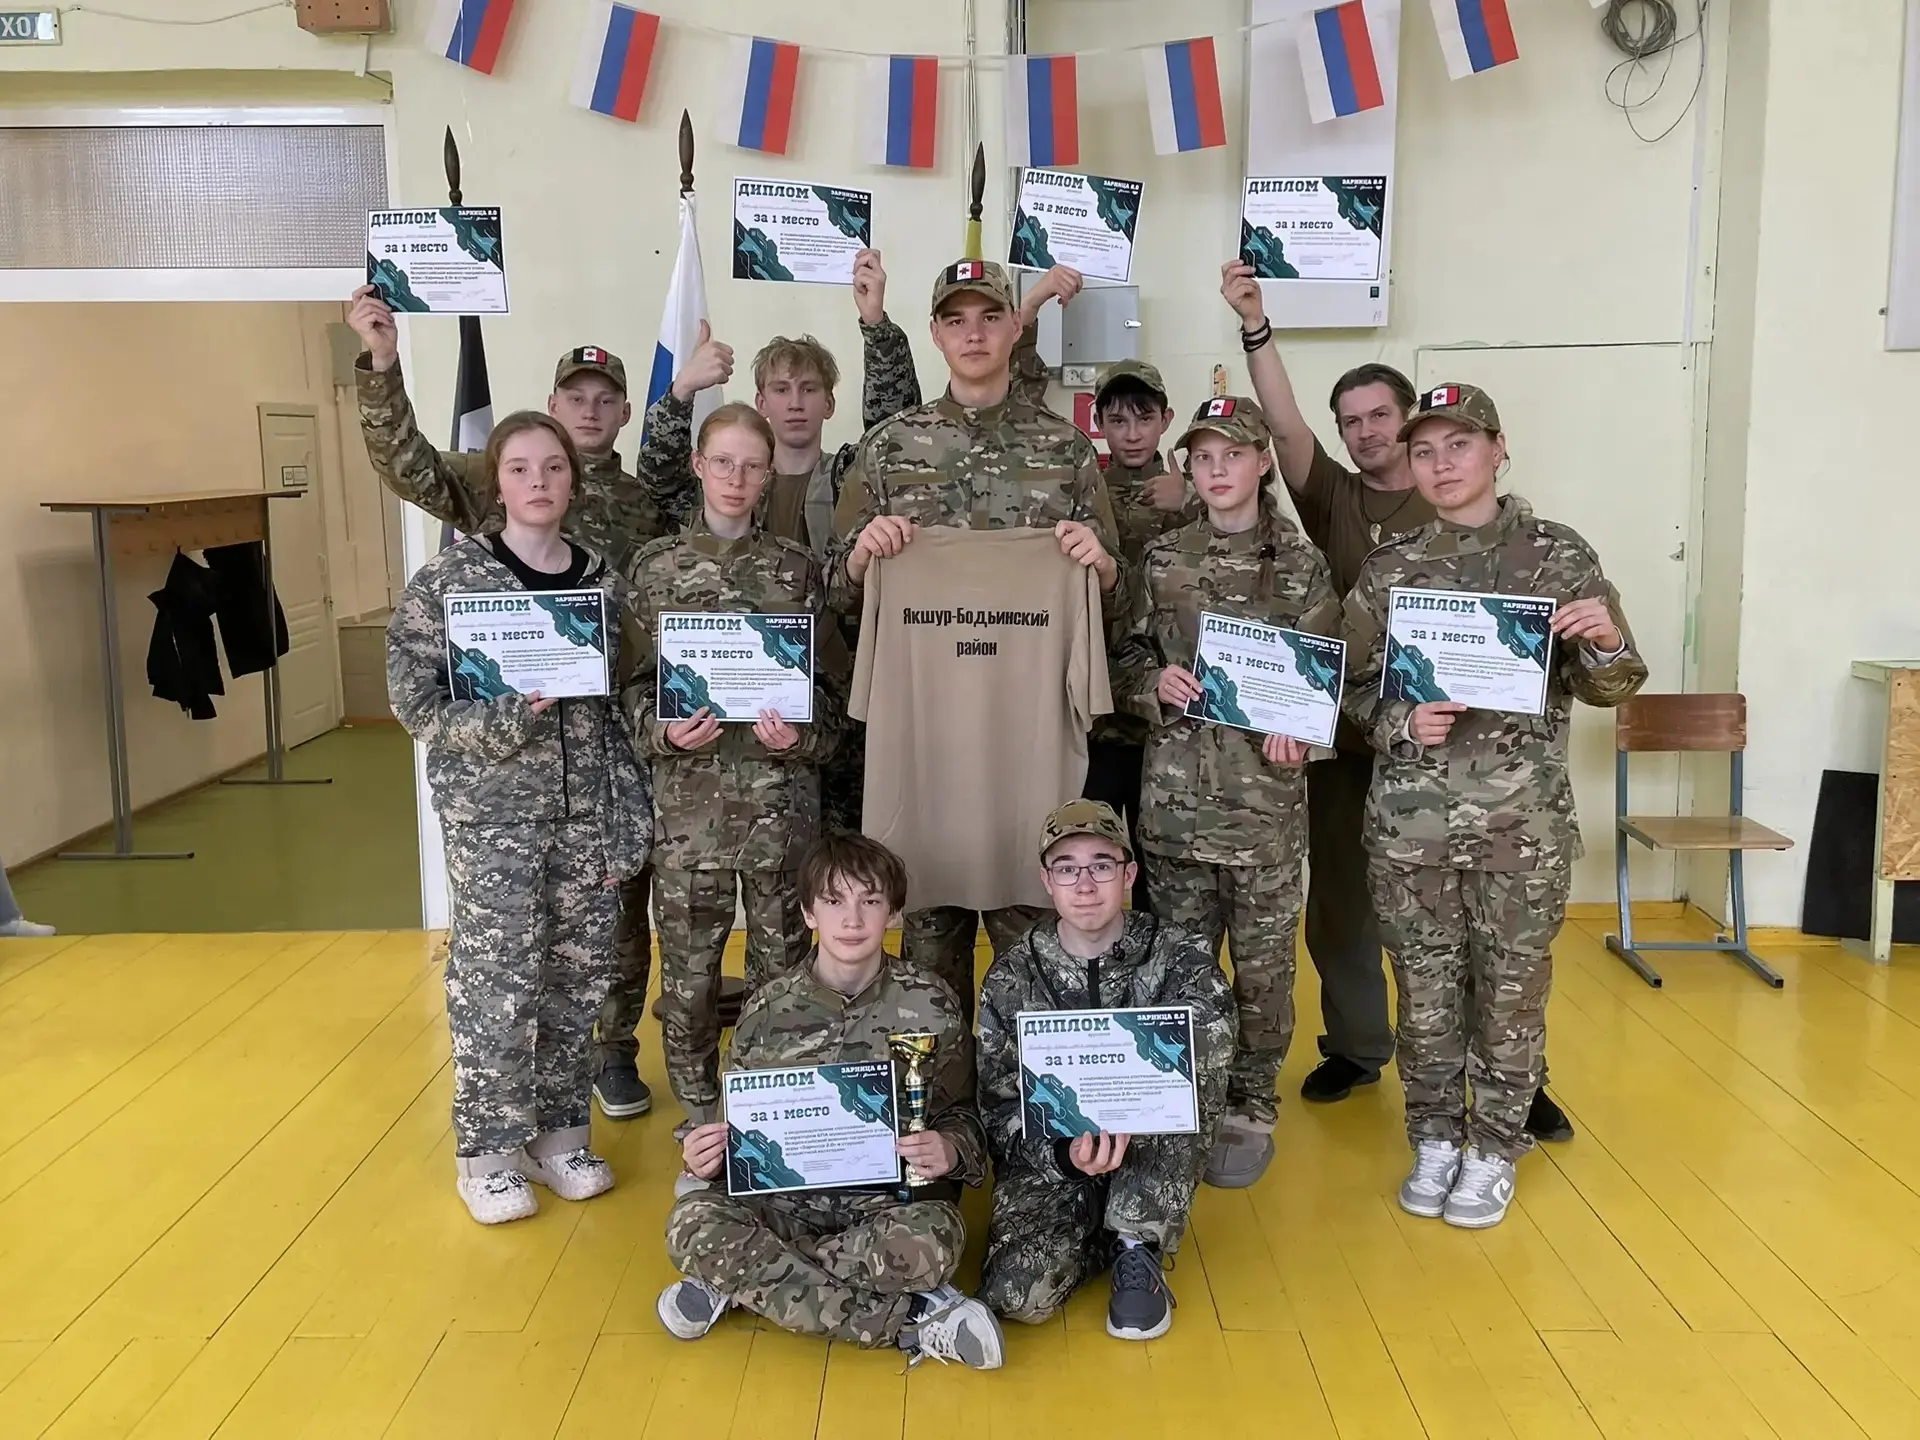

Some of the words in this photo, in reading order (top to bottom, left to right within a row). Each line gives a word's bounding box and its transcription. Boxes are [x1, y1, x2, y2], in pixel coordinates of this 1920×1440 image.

[0, 16, 39, 37] ХО
[1025, 171, 1084, 189] ДИПЛОМ
[1248, 180, 1319, 195] ДИПЛОМ
[739, 183, 809, 199] ДИПЛОМ
[371, 212, 436, 227] ДИПЛОМ
[772, 215, 777, 223] 1
[1291, 221, 1296, 229] 1
[402, 244, 407, 252] 1
[450, 599, 531, 615] ДИПЛОМ
[1395, 596, 1477, 613] ДИПЛОМ
[1502, 602, 1536, 610] ЗАРНИЦА
[664, 617, 742, 632] ДИПЛОМ
[903, 607, 1050, 628] Якшур-Бодьинский
[491, 632, 497, 641] 1
[1205, 618, 1276, 644] ДИПЛОМ
[1431, 631, 1436, 640] 1
[956, 638, 998, 657] район
[1299, 637, 1329, 648] ЗАРНИЦА
[701, 649, 708, 659] 3
[1236, 655, 1242, 664] 1
[1024, 1018, 1110, 1036] ДИПЛОМ
[1068, 1055, 1074, 1065] 1
[841, 1066, 876, 1074] ЗАРНИЦА
[729, 1071, 815, 1094] ДИПЛОМ
[772, 1110, 779, 1121] 1
